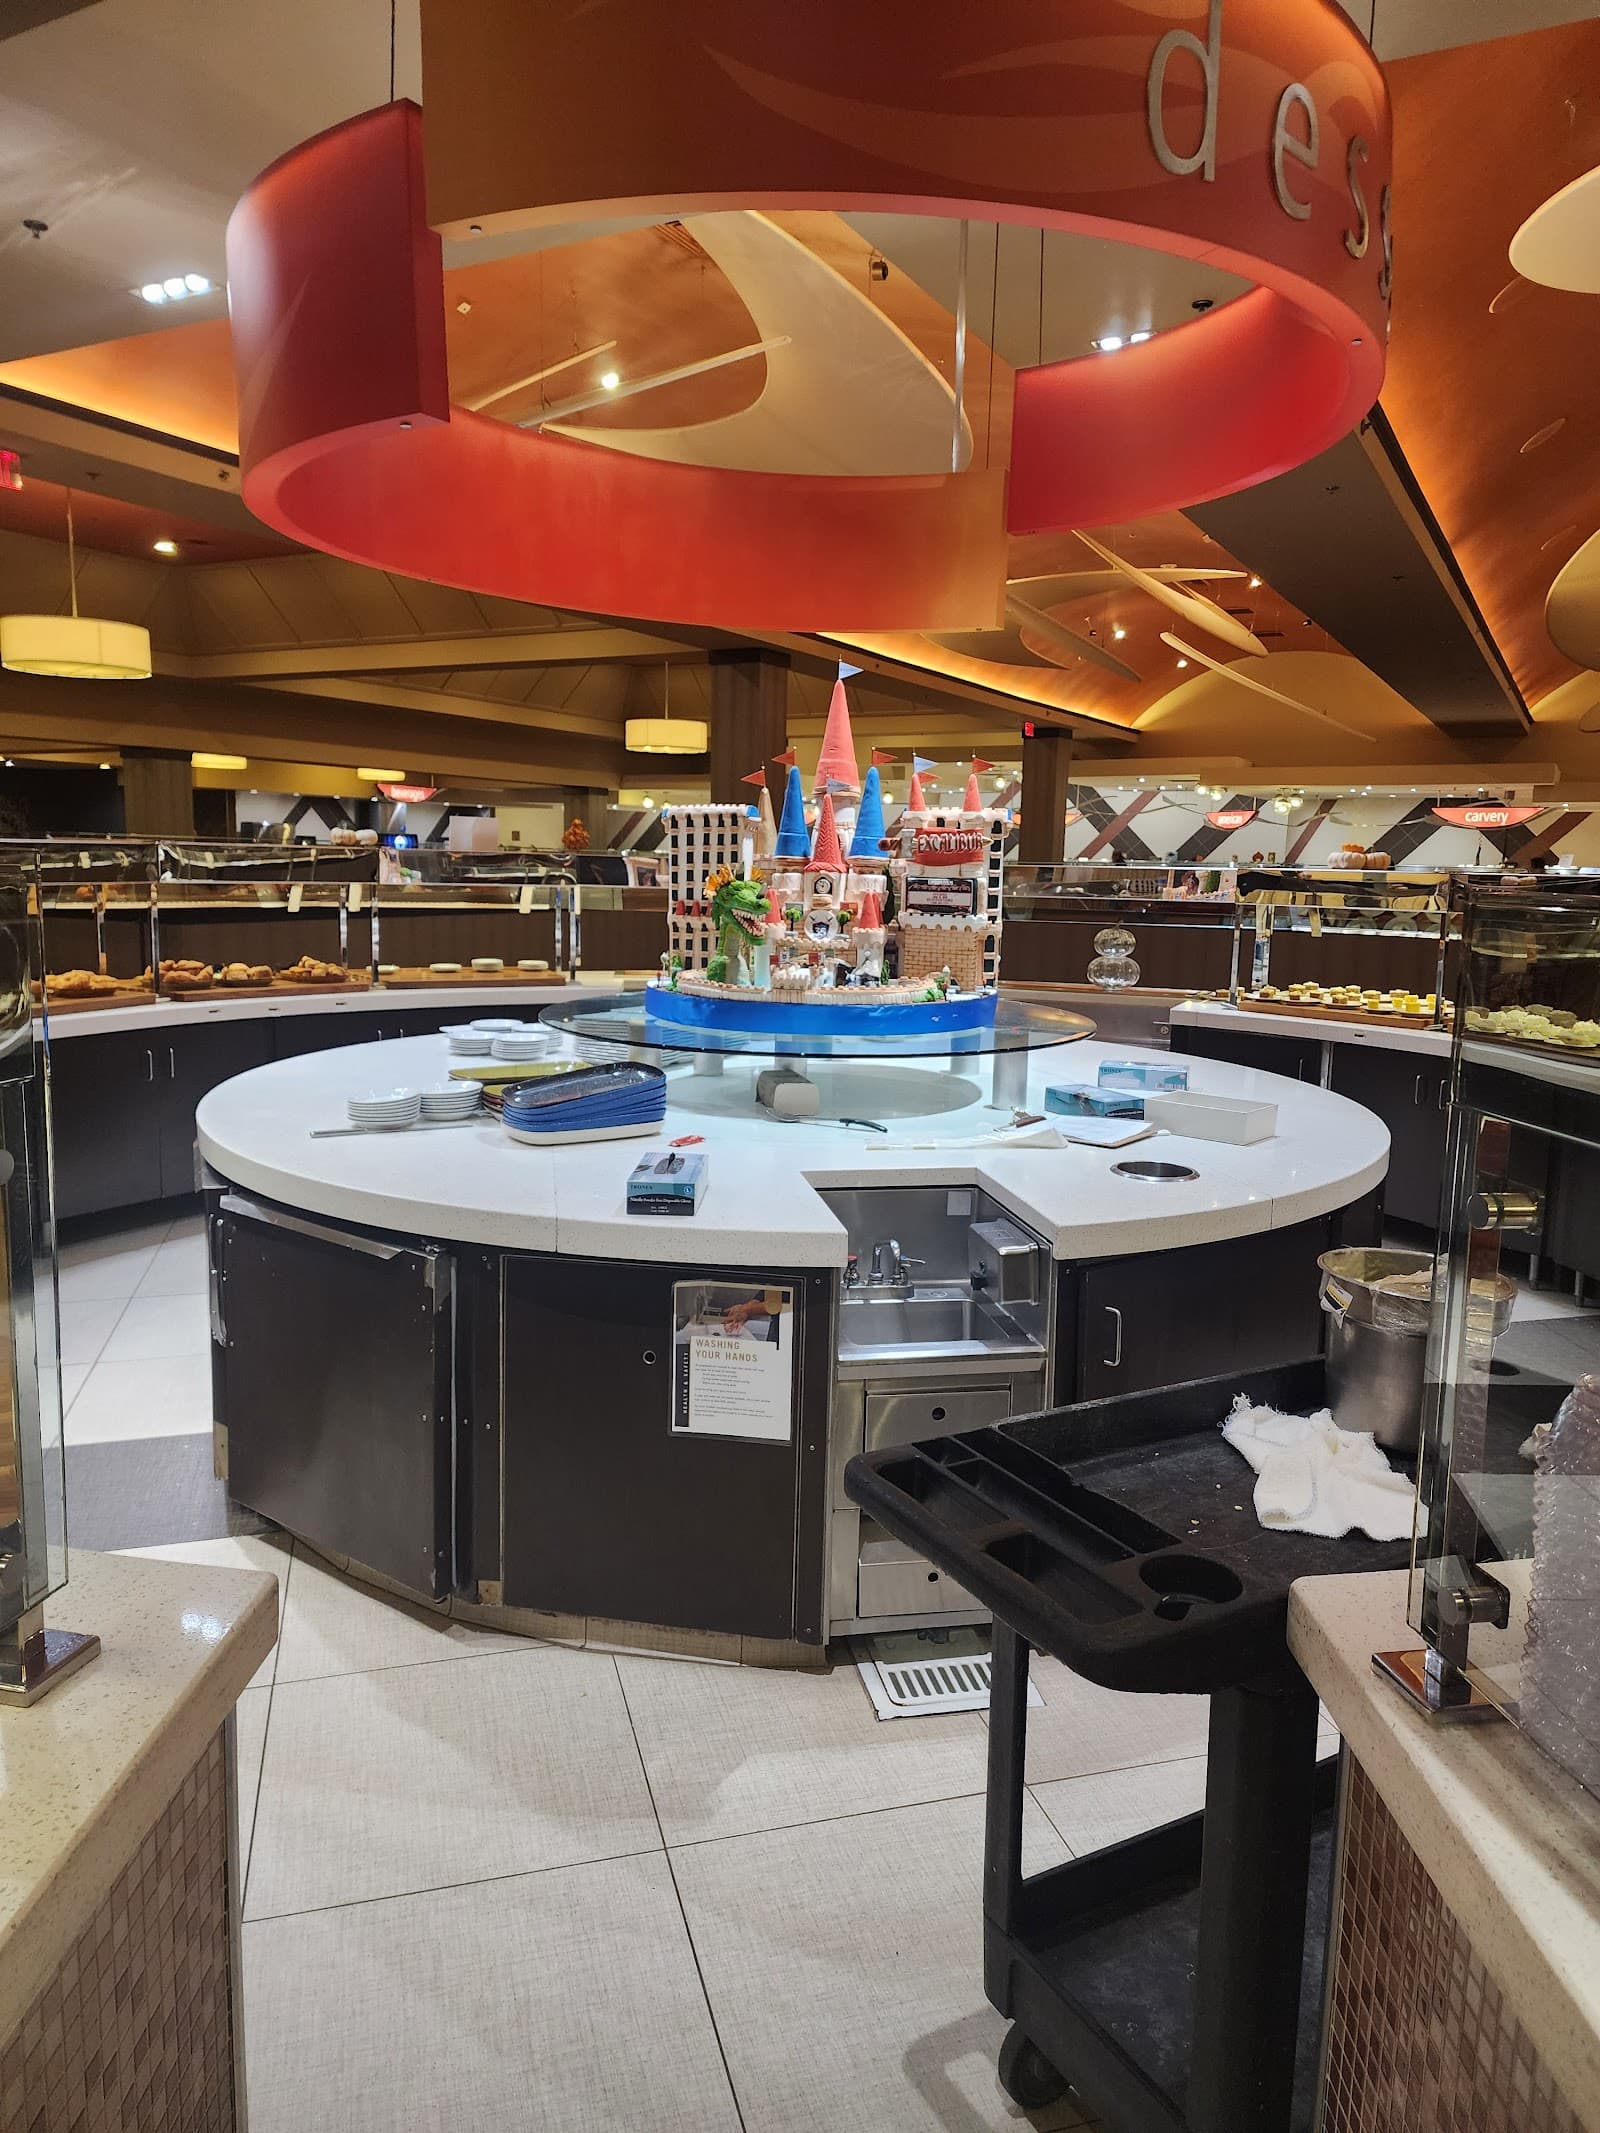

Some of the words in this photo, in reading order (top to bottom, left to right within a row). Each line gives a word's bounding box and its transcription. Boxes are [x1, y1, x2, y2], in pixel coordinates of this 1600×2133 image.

[1464, 810, 1509, 826] carvery
[918, 832, 983, 854] EXCALIBUR
[696, 1339, 740, 1350] WASHING
[696, 1350, 720, 1359] YOUR
[726, 1352, 758, 1361] HANDS
